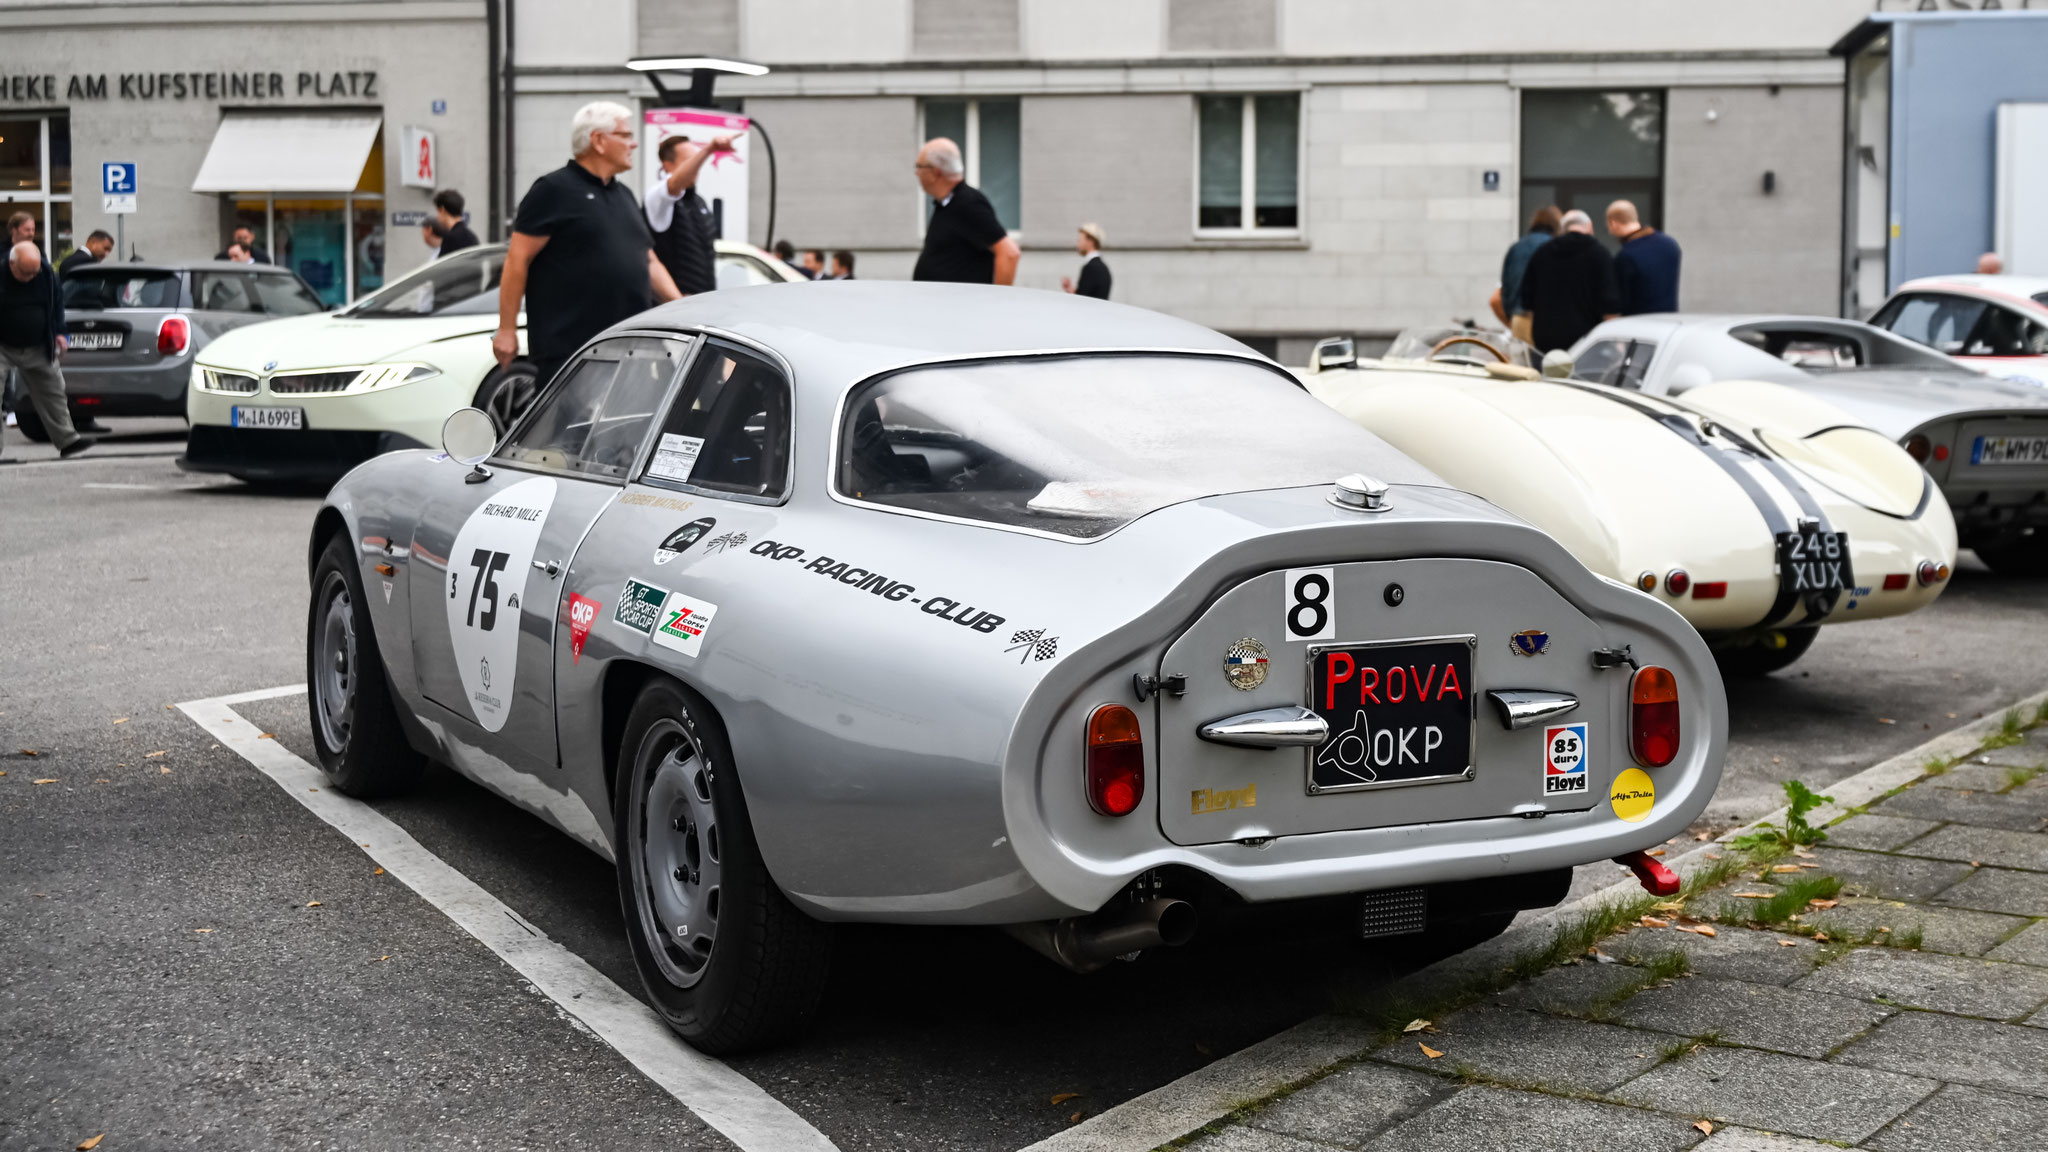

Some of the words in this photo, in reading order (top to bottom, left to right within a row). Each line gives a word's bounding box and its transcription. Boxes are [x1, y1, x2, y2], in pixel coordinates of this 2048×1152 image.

[67, 73, 107, 99] AM
[120, 72, 284, 99] KUFSTEINER
[298, 71, 378, 98] PLATZ
[108, 165, 126, 191] P
[483, 503, 517, 518] RICHARD
[516, 508, 543, 521] MILLE
[1788, 532, 1841, 559] 248
[450, 572, 458, 599] 3
[1792, 561, 1845, 591] XUX
[466, 548, 511, 631] 75
[637, 587, 649, 600] GT
[571, 601, 594, 624] OKP
[634, 600, 661, 617] SPORTS
[1287, 573, 1330, 637] 8
[626, 610, 640, 624] CAR
[638, 614, 654, 628] CUP
[682, 618, 705, 629] corse
[1373, 726, 1443, 766] OKP
[1554, 738, 1578, 753] 85
[1554, 755, 1579, 764] duro
[1546, 774, 1586, 793] Floyd
[1191, 783, 1257, 815] Floyd
[1611, 792, 1631, 801] Alfa
[1629, 790, 1653, 798] Delta
